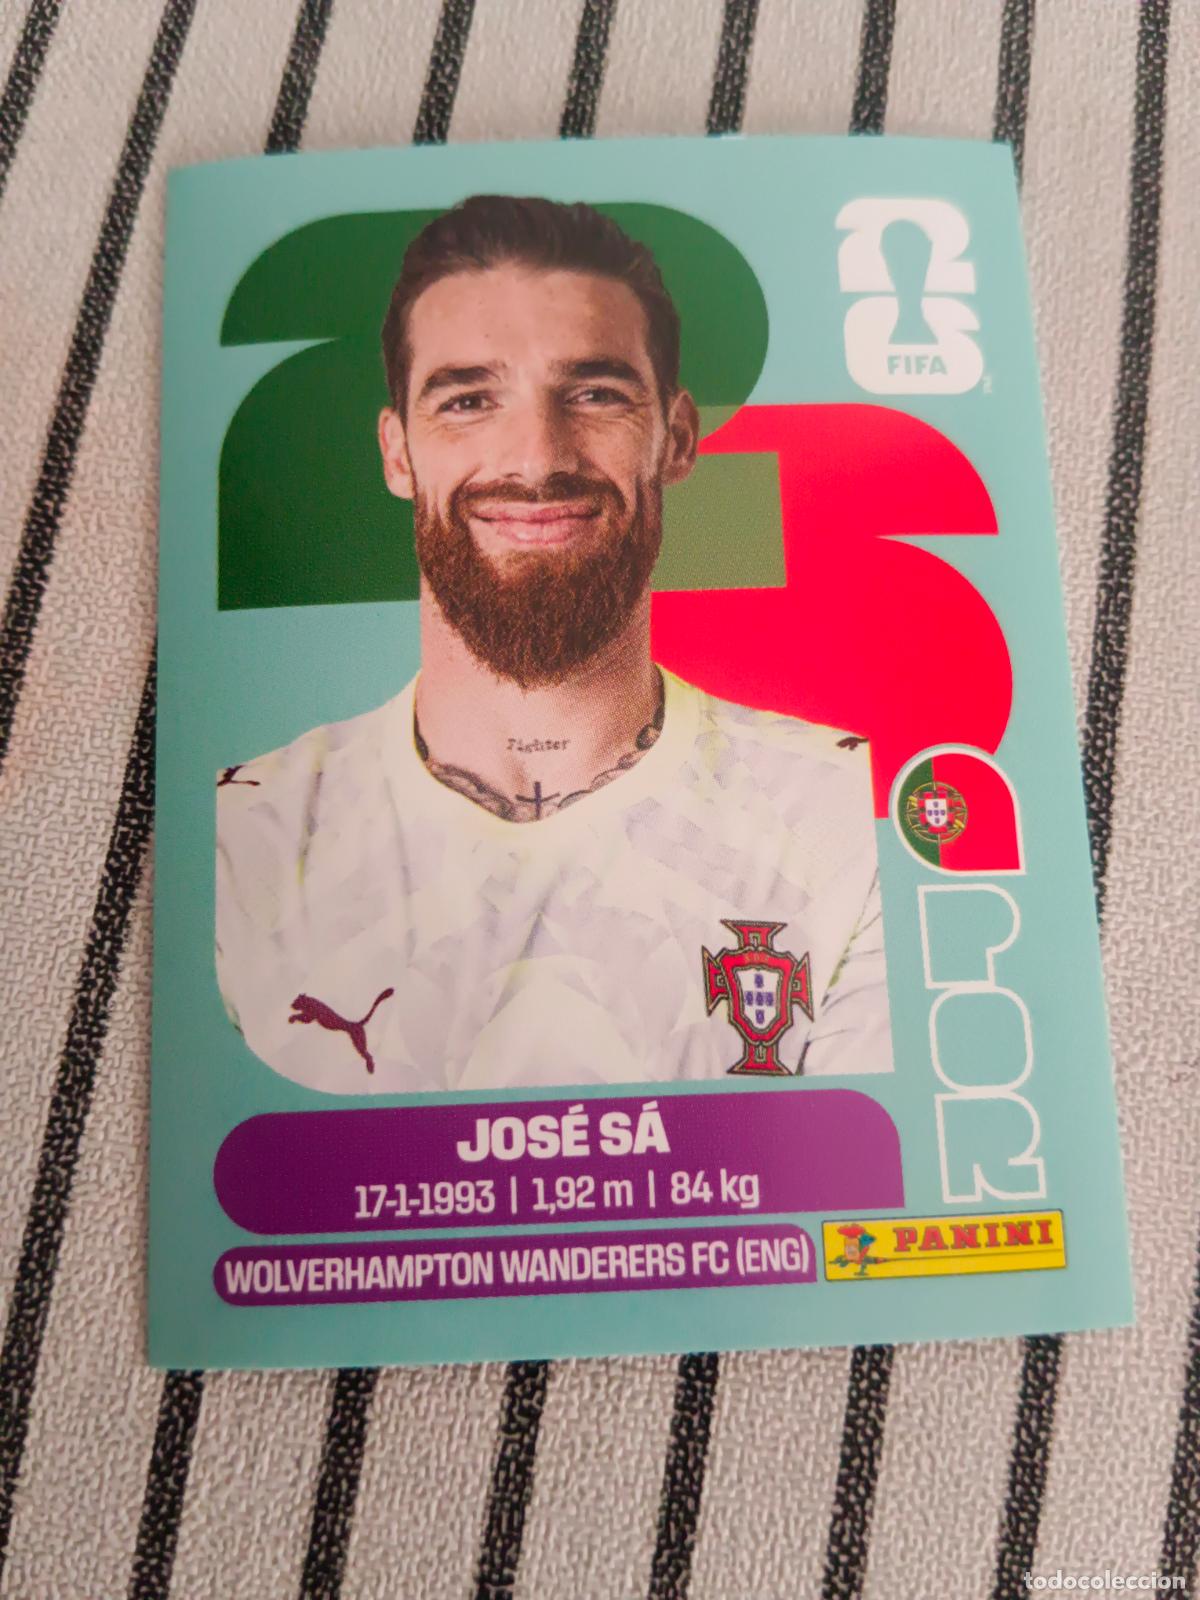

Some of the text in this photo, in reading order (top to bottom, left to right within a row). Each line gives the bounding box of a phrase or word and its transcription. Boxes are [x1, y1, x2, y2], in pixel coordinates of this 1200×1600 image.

[887, 355, 948, 376] FIFA
[457, 1100, 671, 1163] JOSÉ SÁ
[354, 1179, 496, 1219] 17-1-1993
[532, 1175, 596, 1216] 1,92
[603, 1178, 634, 1208] m
[670, 1170, 713, 1206] 84
[720, 1168, 760, 1209] kg
[892, 1219, 1053, 1252] PANINI
[224, 1233, 811, 1295] WOLVERHAMPTON WANDERERS FC (ENG)
